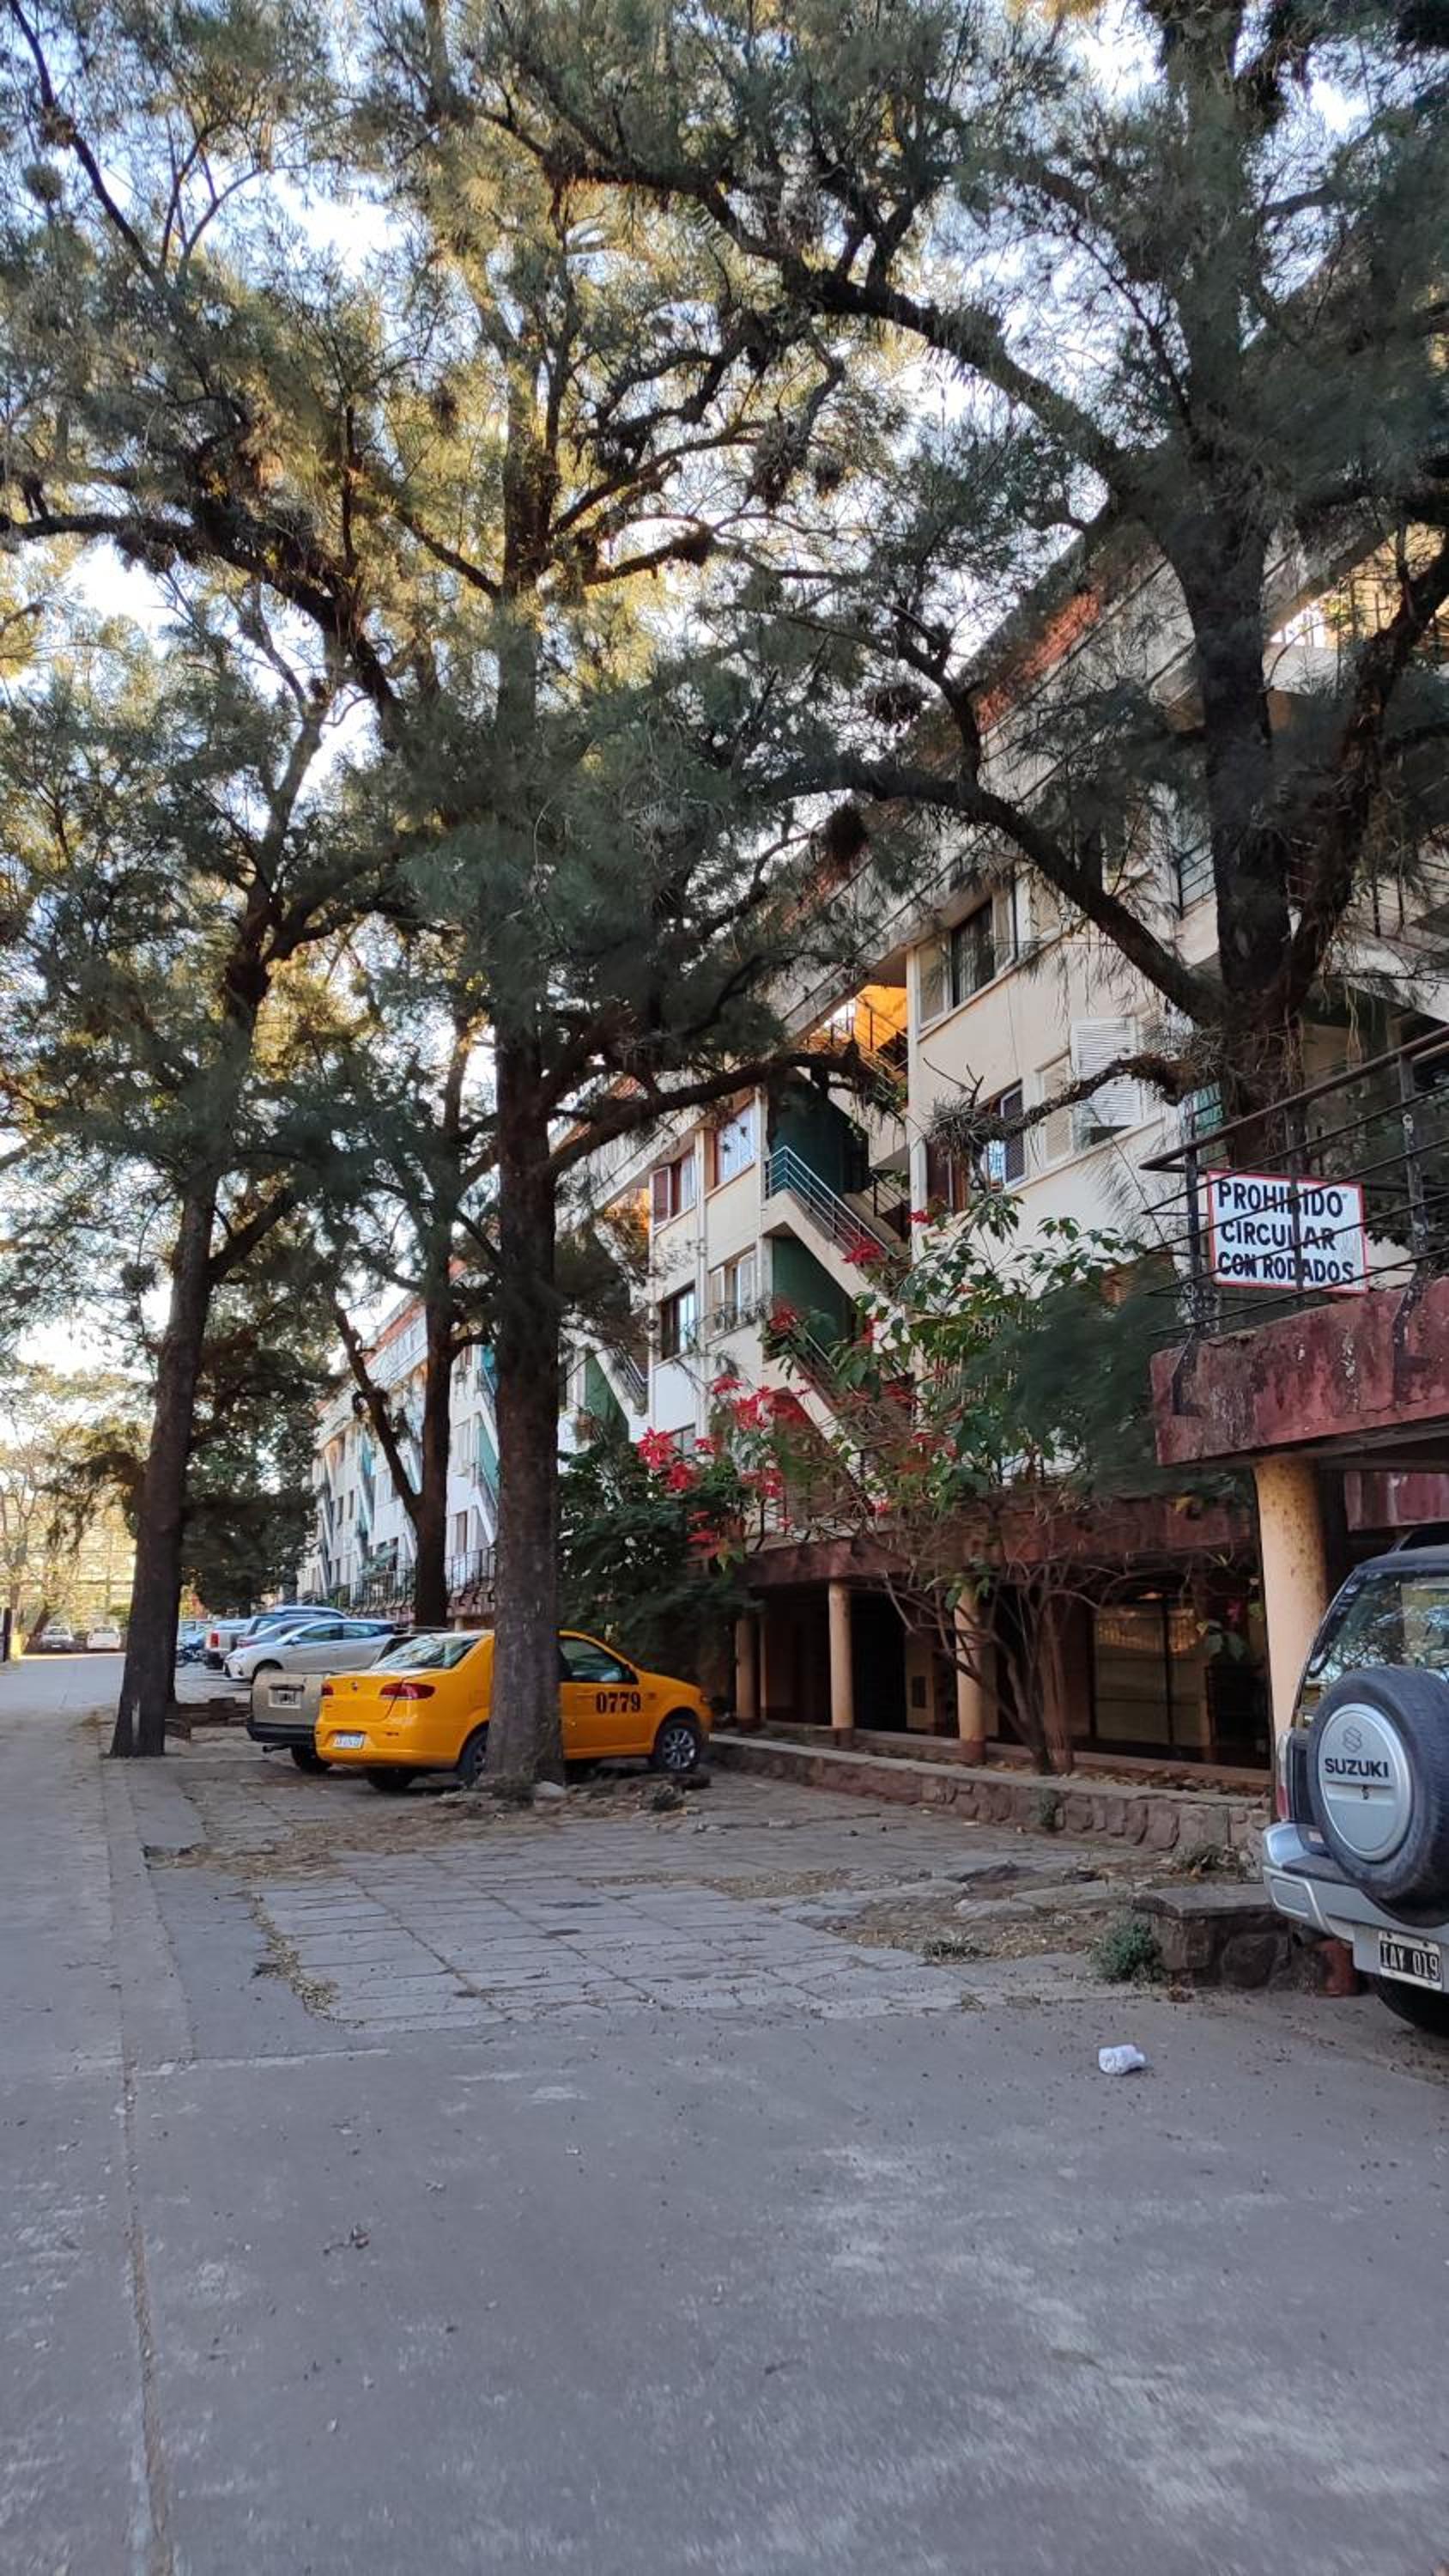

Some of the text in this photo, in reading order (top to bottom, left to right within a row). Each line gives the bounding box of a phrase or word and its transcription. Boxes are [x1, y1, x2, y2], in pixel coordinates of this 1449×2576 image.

[1218, 1251, 1355, 1282] CON RODADOS
[596, 1691, 641, 1715] 0779
[1325, 1758, 1389, 1777] SUZUKI
[1412, 1950, 1440, 1981] 019
